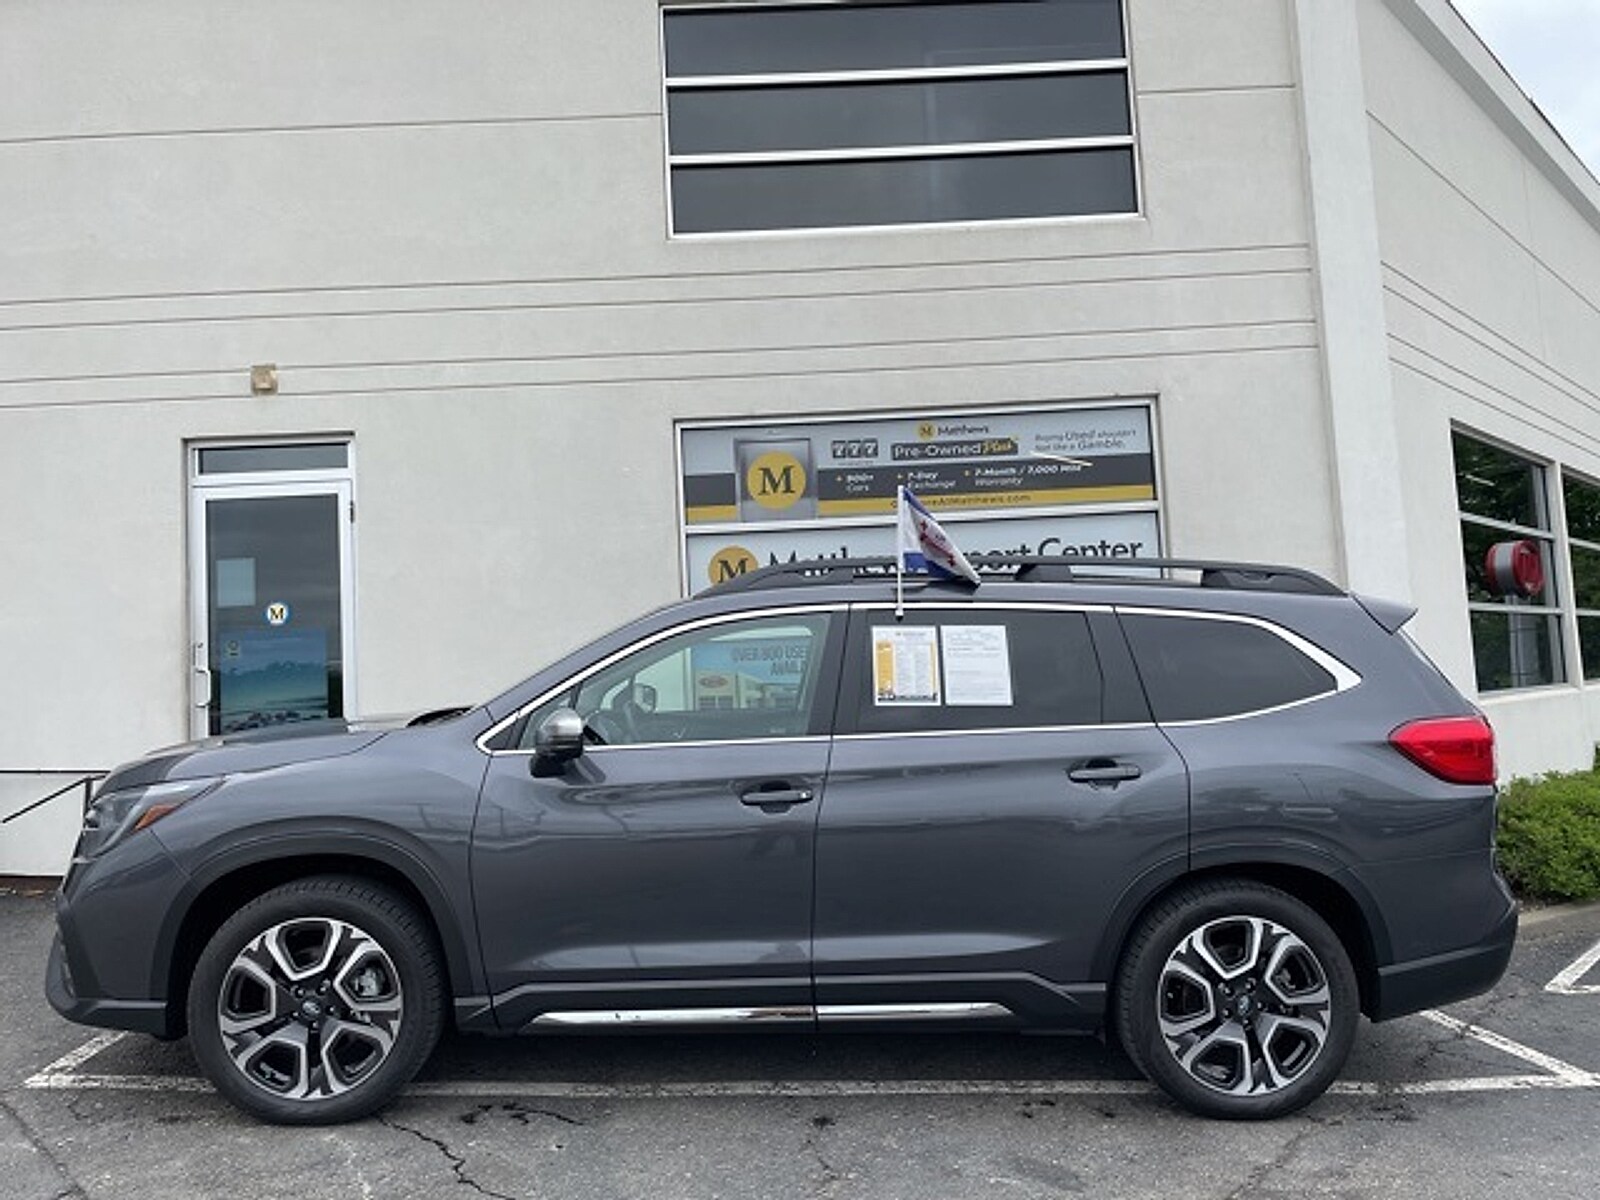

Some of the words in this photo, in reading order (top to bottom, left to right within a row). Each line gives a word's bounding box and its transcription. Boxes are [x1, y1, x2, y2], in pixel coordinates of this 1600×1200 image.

[938, 424, 989, 436] Matthews
[1065, 429, 1096, 441] Used
[894, 441, 981, 459] Pre-Owned
[757, 465, 795, 496] M
[975, 477, 1024, 486] Warranty
[1038, 536, 1143, 562] Center
